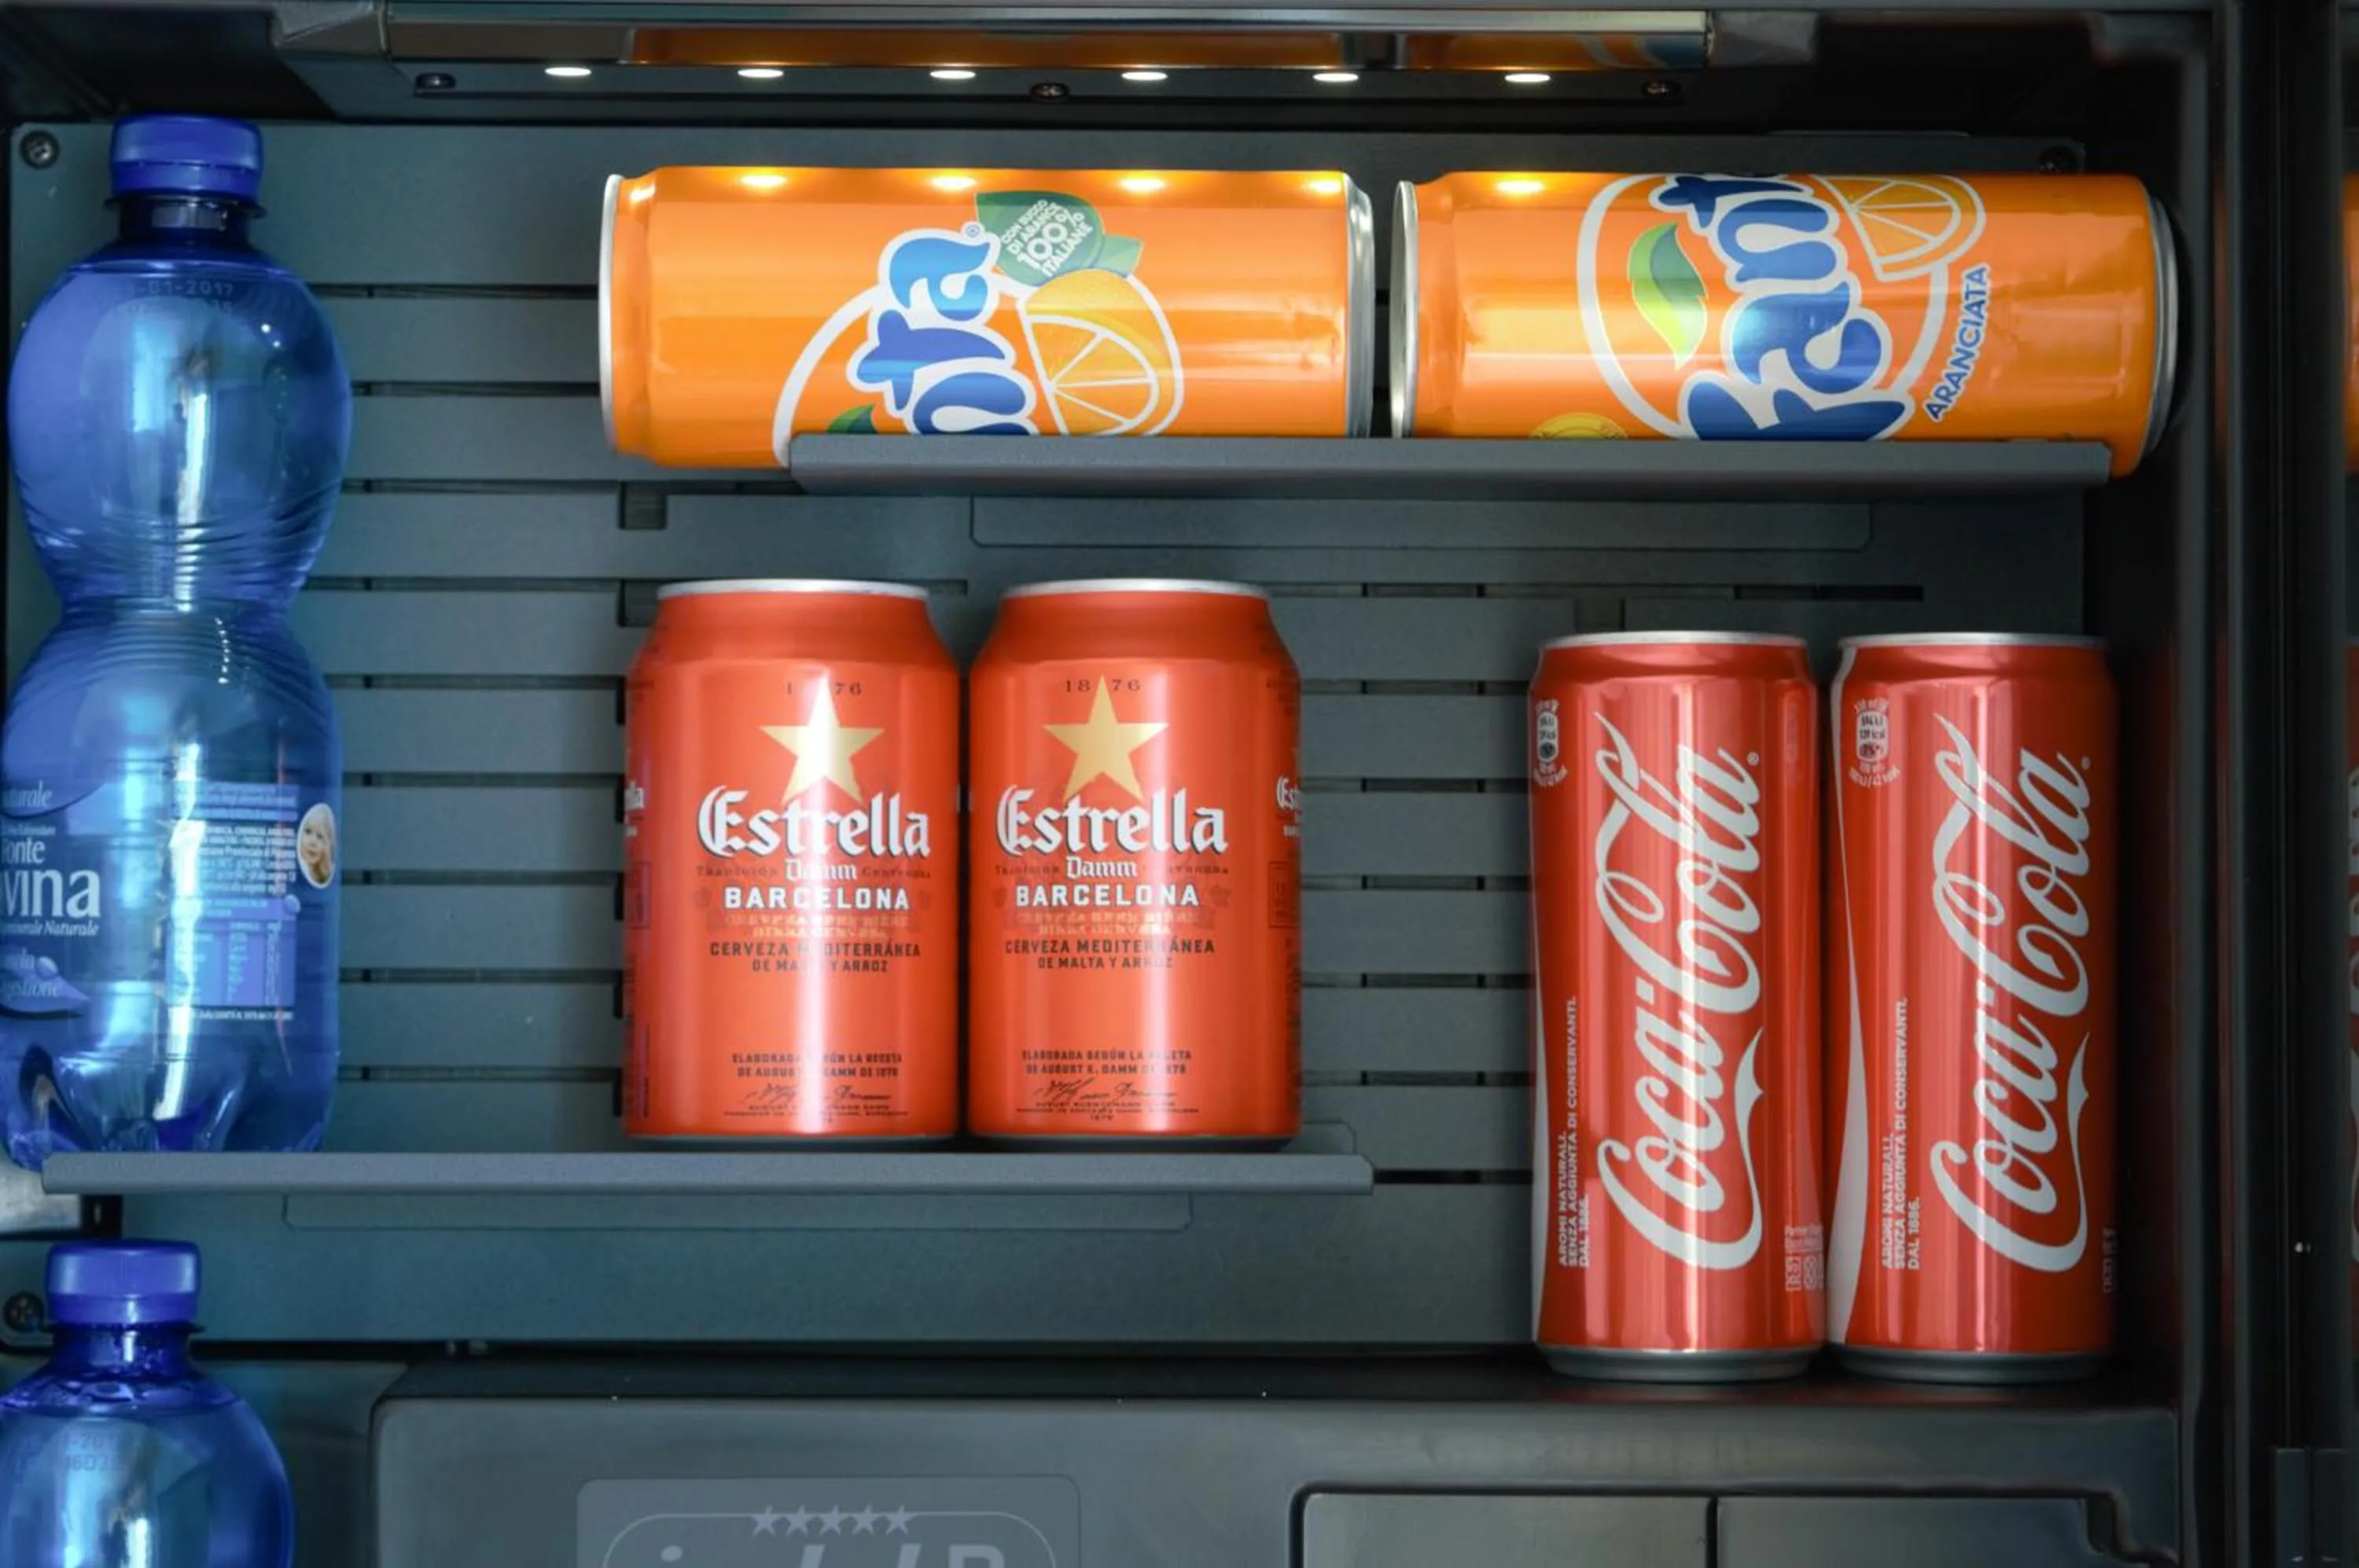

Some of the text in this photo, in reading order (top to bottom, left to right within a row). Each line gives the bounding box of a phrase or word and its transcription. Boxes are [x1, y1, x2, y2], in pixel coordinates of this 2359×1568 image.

[1016, 206, 1085, 271] 100%
[1657, 175, 1907, 440] Fant
[1923, 263, 1989, 422] ARANCIATA
[697, 785, 931, 858] Estrella
[996, 785, 1228, 856] Estrella
[1065, 855, 1139, 879] Damm
[2, 868, 101, 918] vina
[724, 886, 910, 910] BARCELONA
[1015, 884, 1200, 907] BARCELONA
[710, 943, 788, 957] CERVEZA
[752, 959, 770, 973] DE
[842, 959, 889, 973] ARROZ
[1005, 939, 1070, 954] CERVEZA
[1037, 957, 1054, 969] DE
[1058, 957, 1105, 970] MALTA
[1109, 957, 1117, 969] Y
[1595, 711, 1764, 1270] Coca-Cola
[1930, 712, 2090, 1272] Coca-Cola
[1567, 1113, 1577, 1128] DI
[1895, 1114, 1906, 1130] DI
[1568, 1132, 1577, 1212] AGGIUNTA
[1895, 1135, 1906, 1213] AGGIUNTA
[1568, 1218, 1578, 1268] SENZA
[1895, 1219, 1906, 1269] SENZA
[1908, 1237, 1919, 1270] DAL
